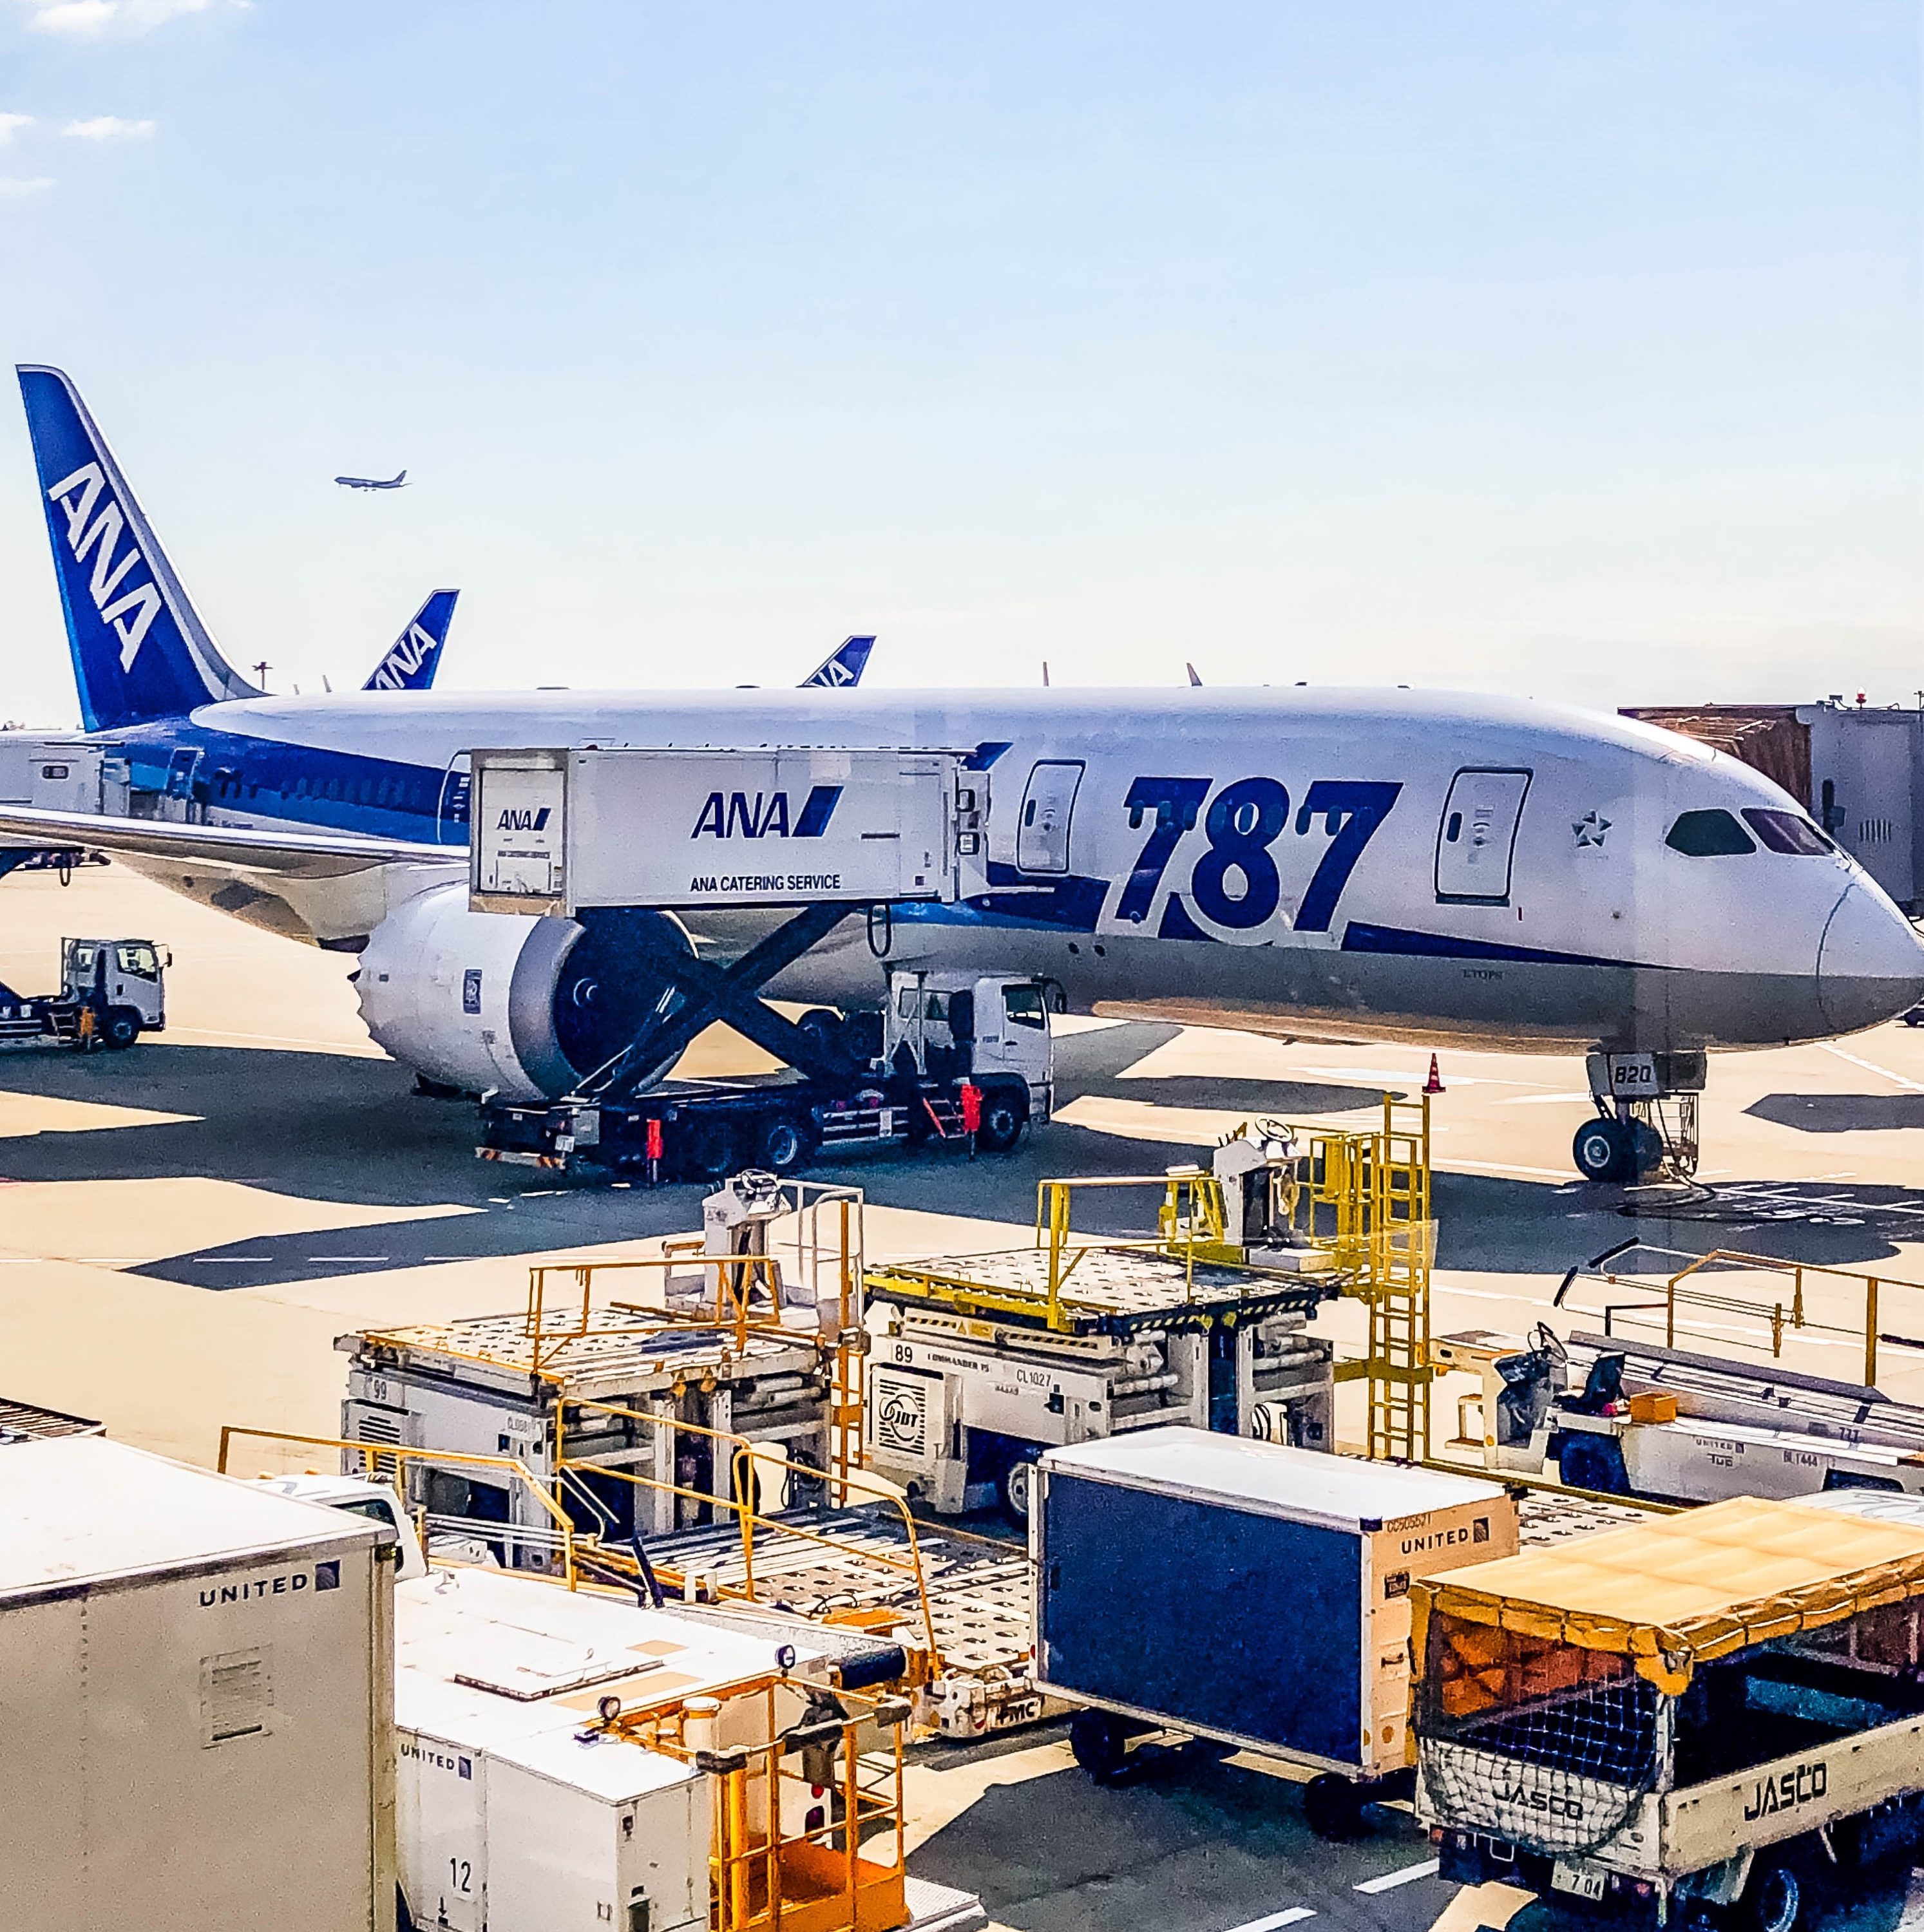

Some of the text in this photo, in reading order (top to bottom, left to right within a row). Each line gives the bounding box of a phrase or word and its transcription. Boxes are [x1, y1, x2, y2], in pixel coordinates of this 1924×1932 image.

[48, 462, 161, 674] ANA
[376, 622, 437, 688] ANA
[497, 810, 531, 831] ANA
[691, 792, 790, 838] ANA
[1115, 777, 1404, 931] 787
[691, 875, 841, 891] ANA CATERING SERVICE
[895, 1345, 913, 1363] 89
[1017, 1369, 1051, 1387] CL1027
[1696, 1439, 1733, 1450] UNITED
[1401, 1528, 1468, 1555] UNITED
[200, 1574, 308, 1607] UNITED
[401, 1743, 455, 1770] UNITED
[1492, 1781, 1583, 1821] JASCO
[1744, 1762, 1827, 1822] JASCO
[450, 1857, 471, 1893] 12
